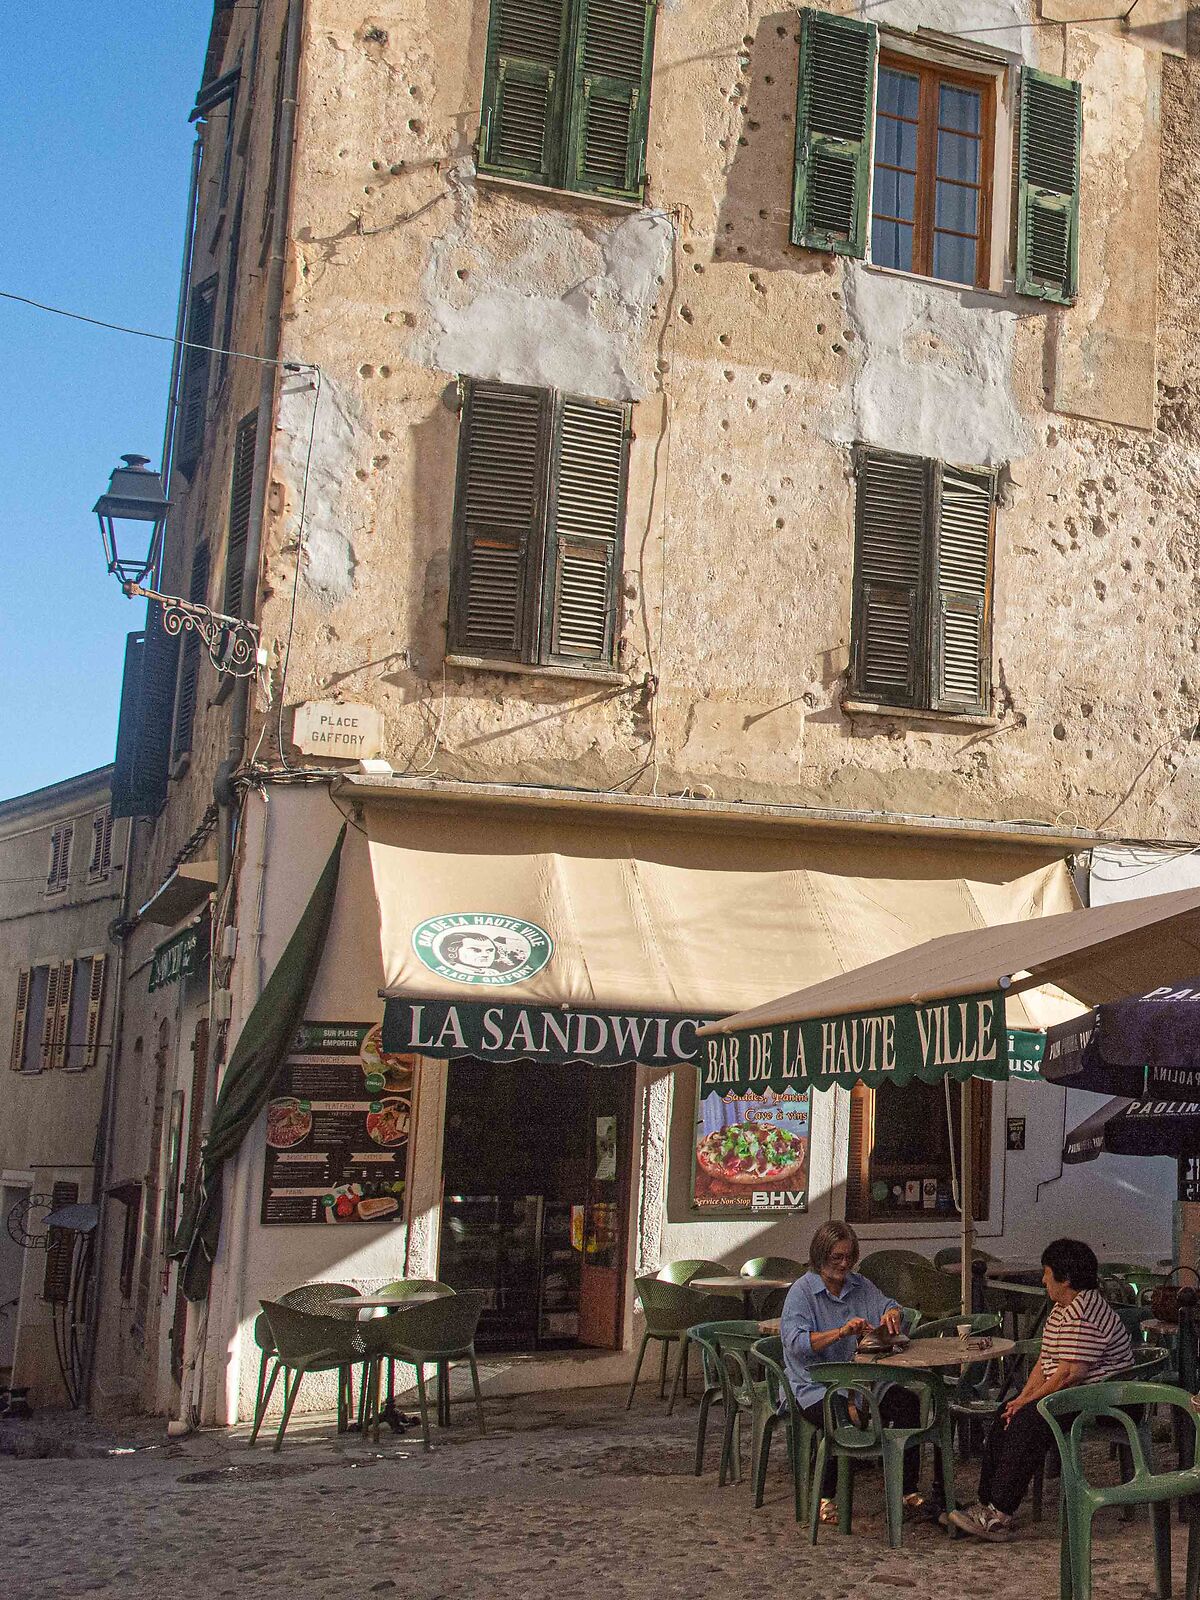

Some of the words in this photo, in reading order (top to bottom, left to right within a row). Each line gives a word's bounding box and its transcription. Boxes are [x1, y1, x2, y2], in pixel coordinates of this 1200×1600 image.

[320, 715, 359, 728] PLACE
[311, 731, 365, 745] GAFFORY
[417, 928, 433, 948] BAR
[433, 919, 449, 932] DE
[450, 916, 469, 927] LA
[473, 916, 523, 931] HAUTE
[519, 926, 545, 948] VILLE
[435, 965, 475, 983] PLACE
[481, 964, 535, 984] GAFFORY
[323, 1029, 336, 1038] SUR
[337, 1030, 358, 1038] PLACE
[407, 1005, 470, 1049] LA
[481, 1007, 718, 1060] SANDWIC
[322, 1039, 358, 1048] EMPORTER
[704, 1038, 741, 1084] BAR
[748, 1031, 773, 1082] DE
[781, 1026, 808, 1079] LA
[820, 1014, 897, 1075] HAUTE
[914, 999, 997, 1068] VILLE
[744, 1108, 773, 1121] Cave
[775, 1108, 784, 1121] à
[787, 1110, 808, 1121] vins
